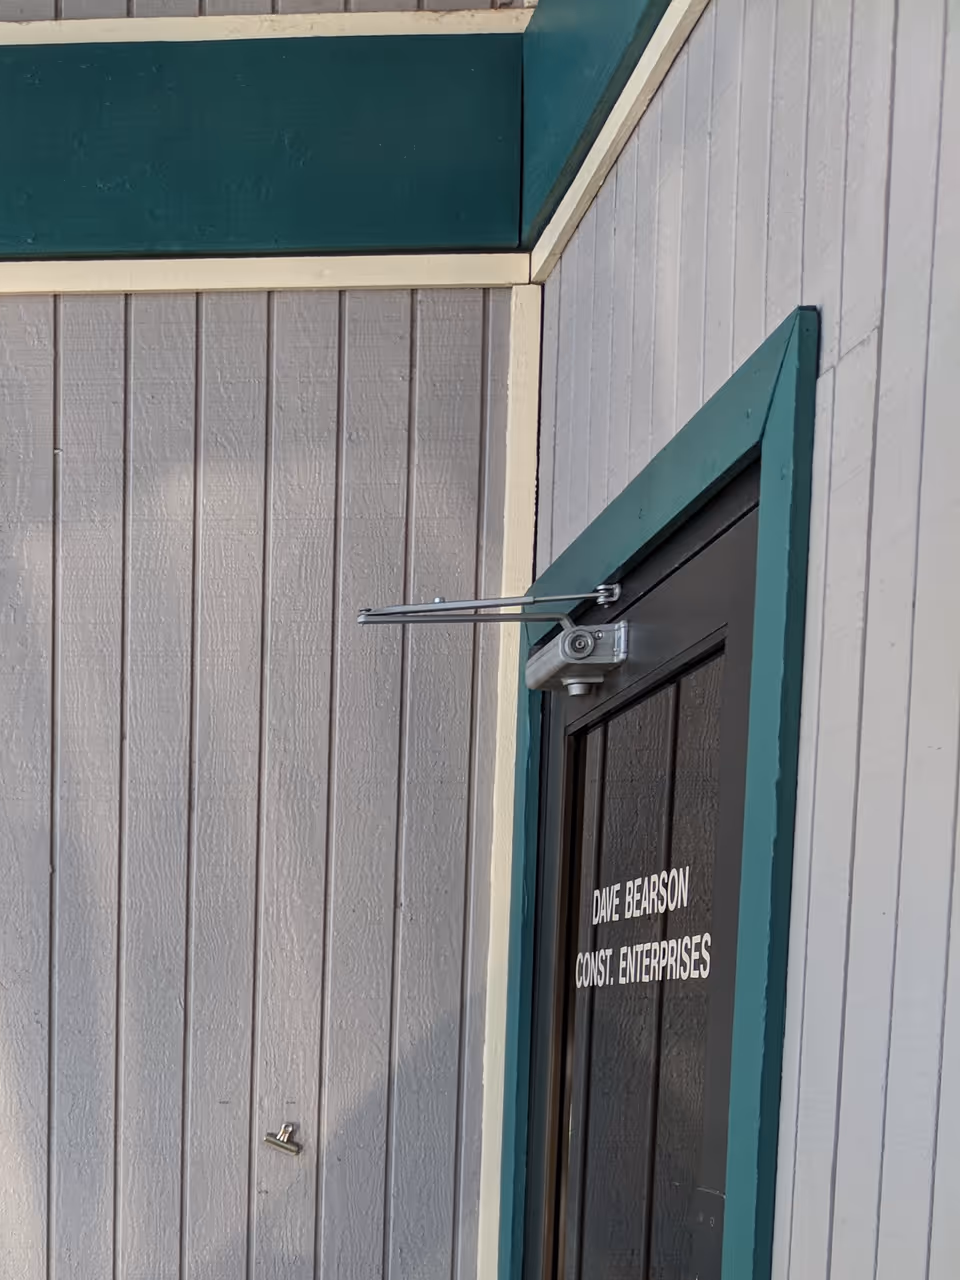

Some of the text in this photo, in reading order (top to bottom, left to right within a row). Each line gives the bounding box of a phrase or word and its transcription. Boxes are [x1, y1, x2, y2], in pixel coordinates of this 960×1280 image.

[592, 866, 690, 926] DAVE BEARSON
[575, 932, 712, 989] CONST. ENTERPRISES
